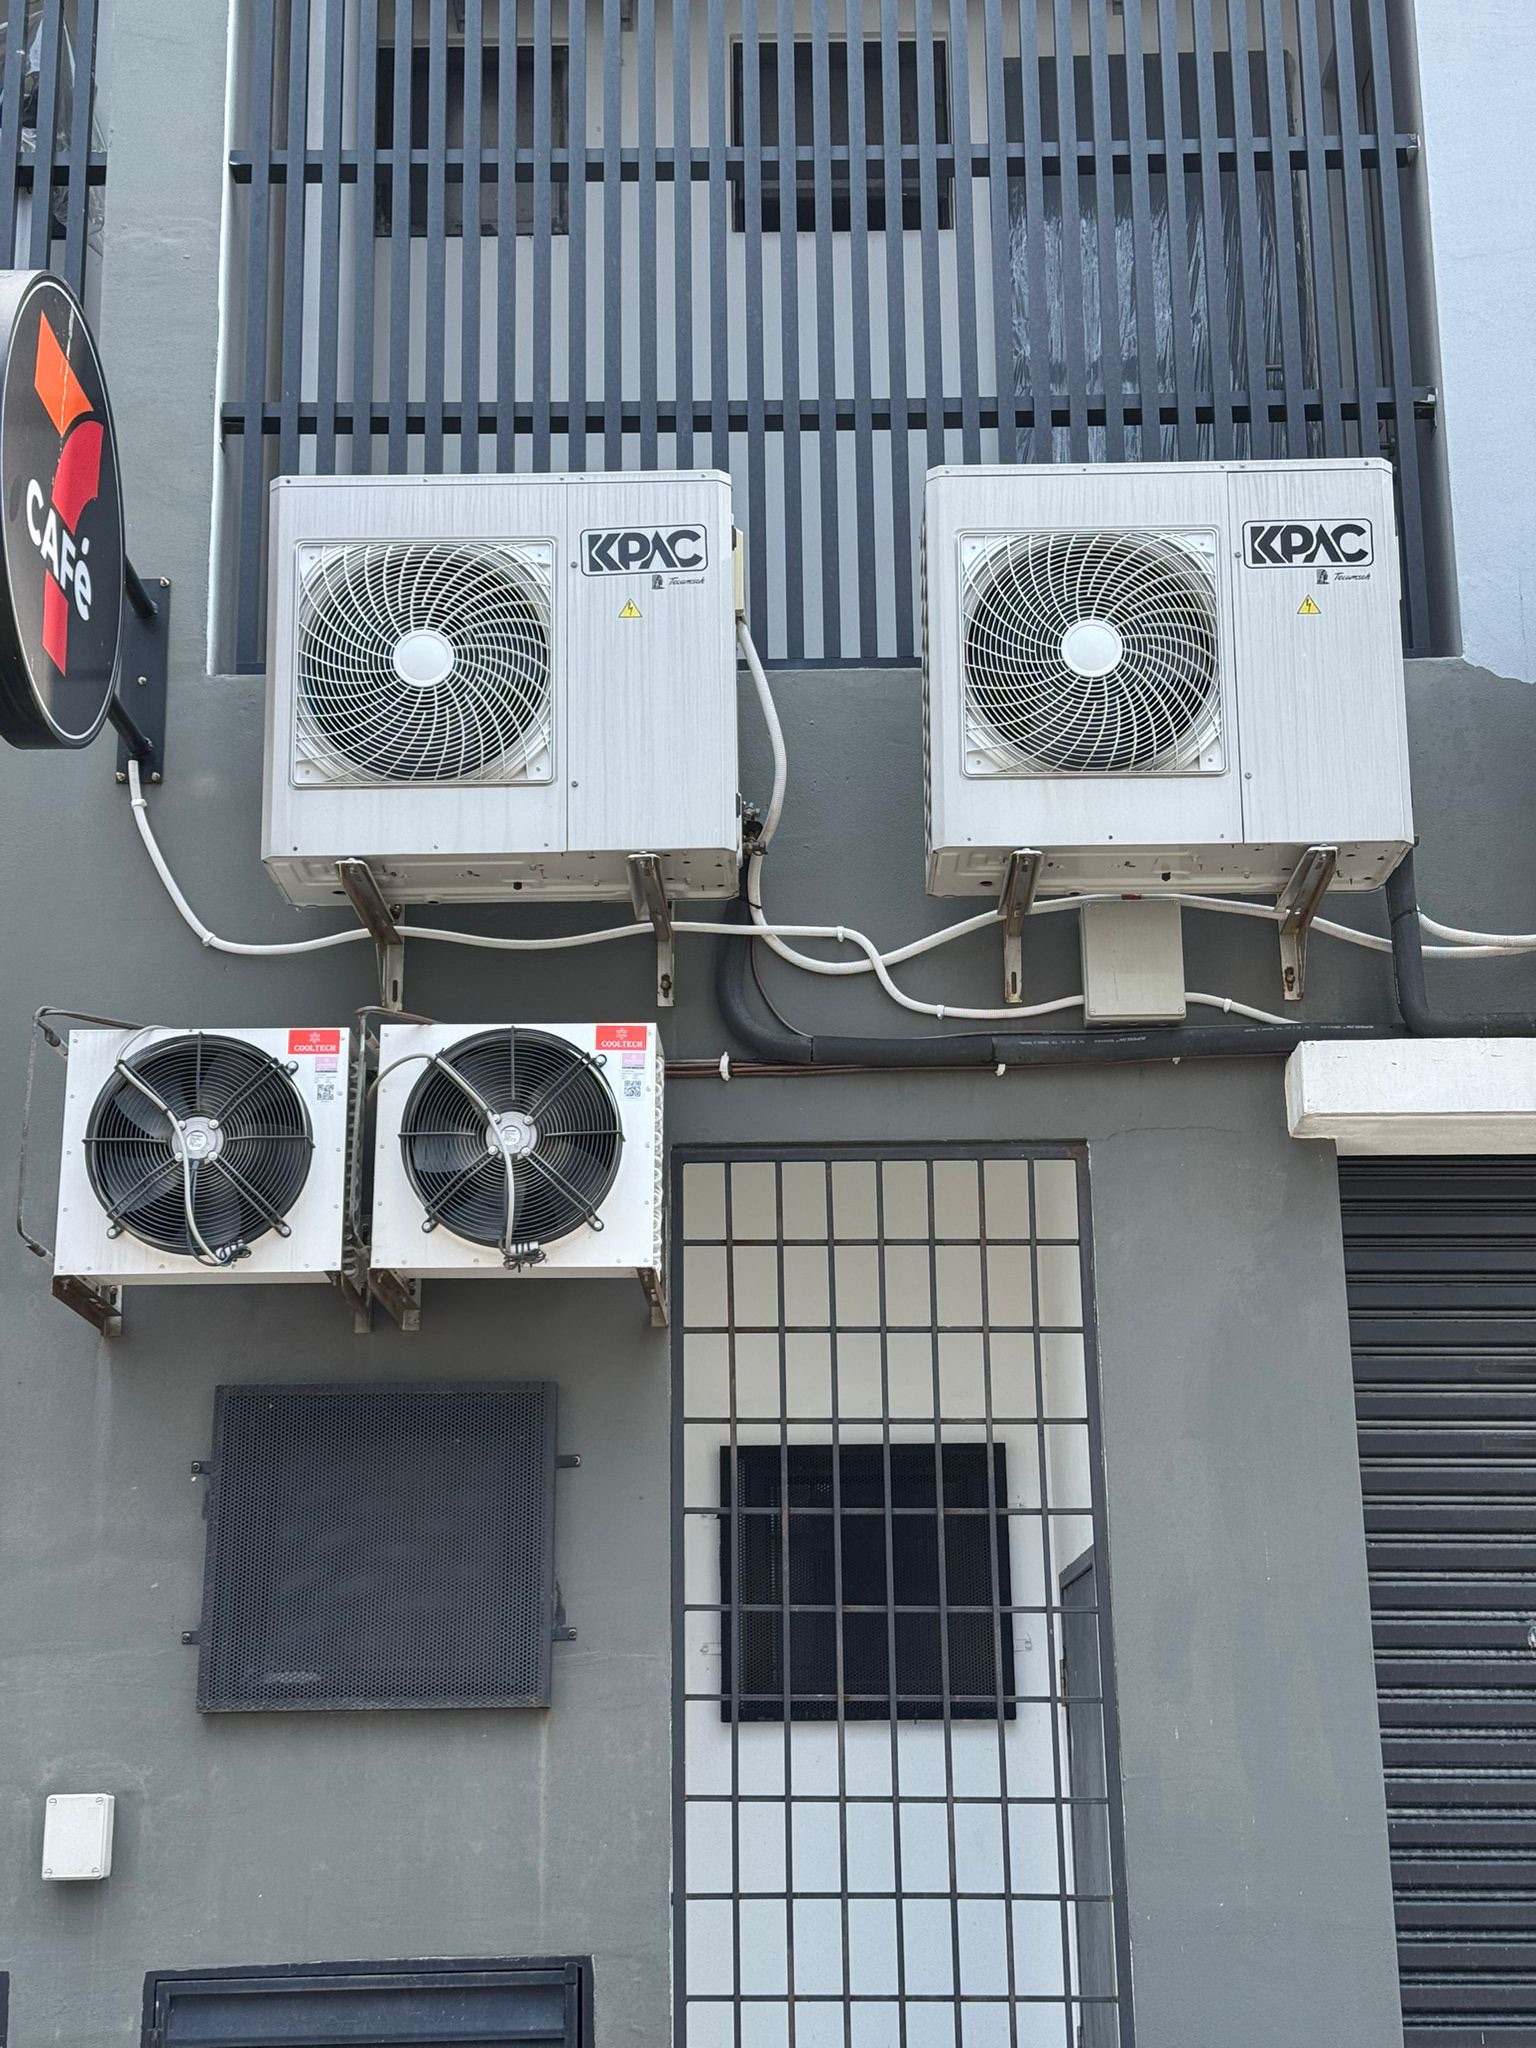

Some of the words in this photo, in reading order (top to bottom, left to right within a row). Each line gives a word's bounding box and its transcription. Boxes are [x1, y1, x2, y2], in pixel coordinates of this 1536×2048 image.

[587, 529, 703, 572] KPAC
[1250, 523, 1369, 564] KPAC
[293, 1044, 337, 1052] COOLTECH
[600, 1040, 643, 1048] COOLTECH
